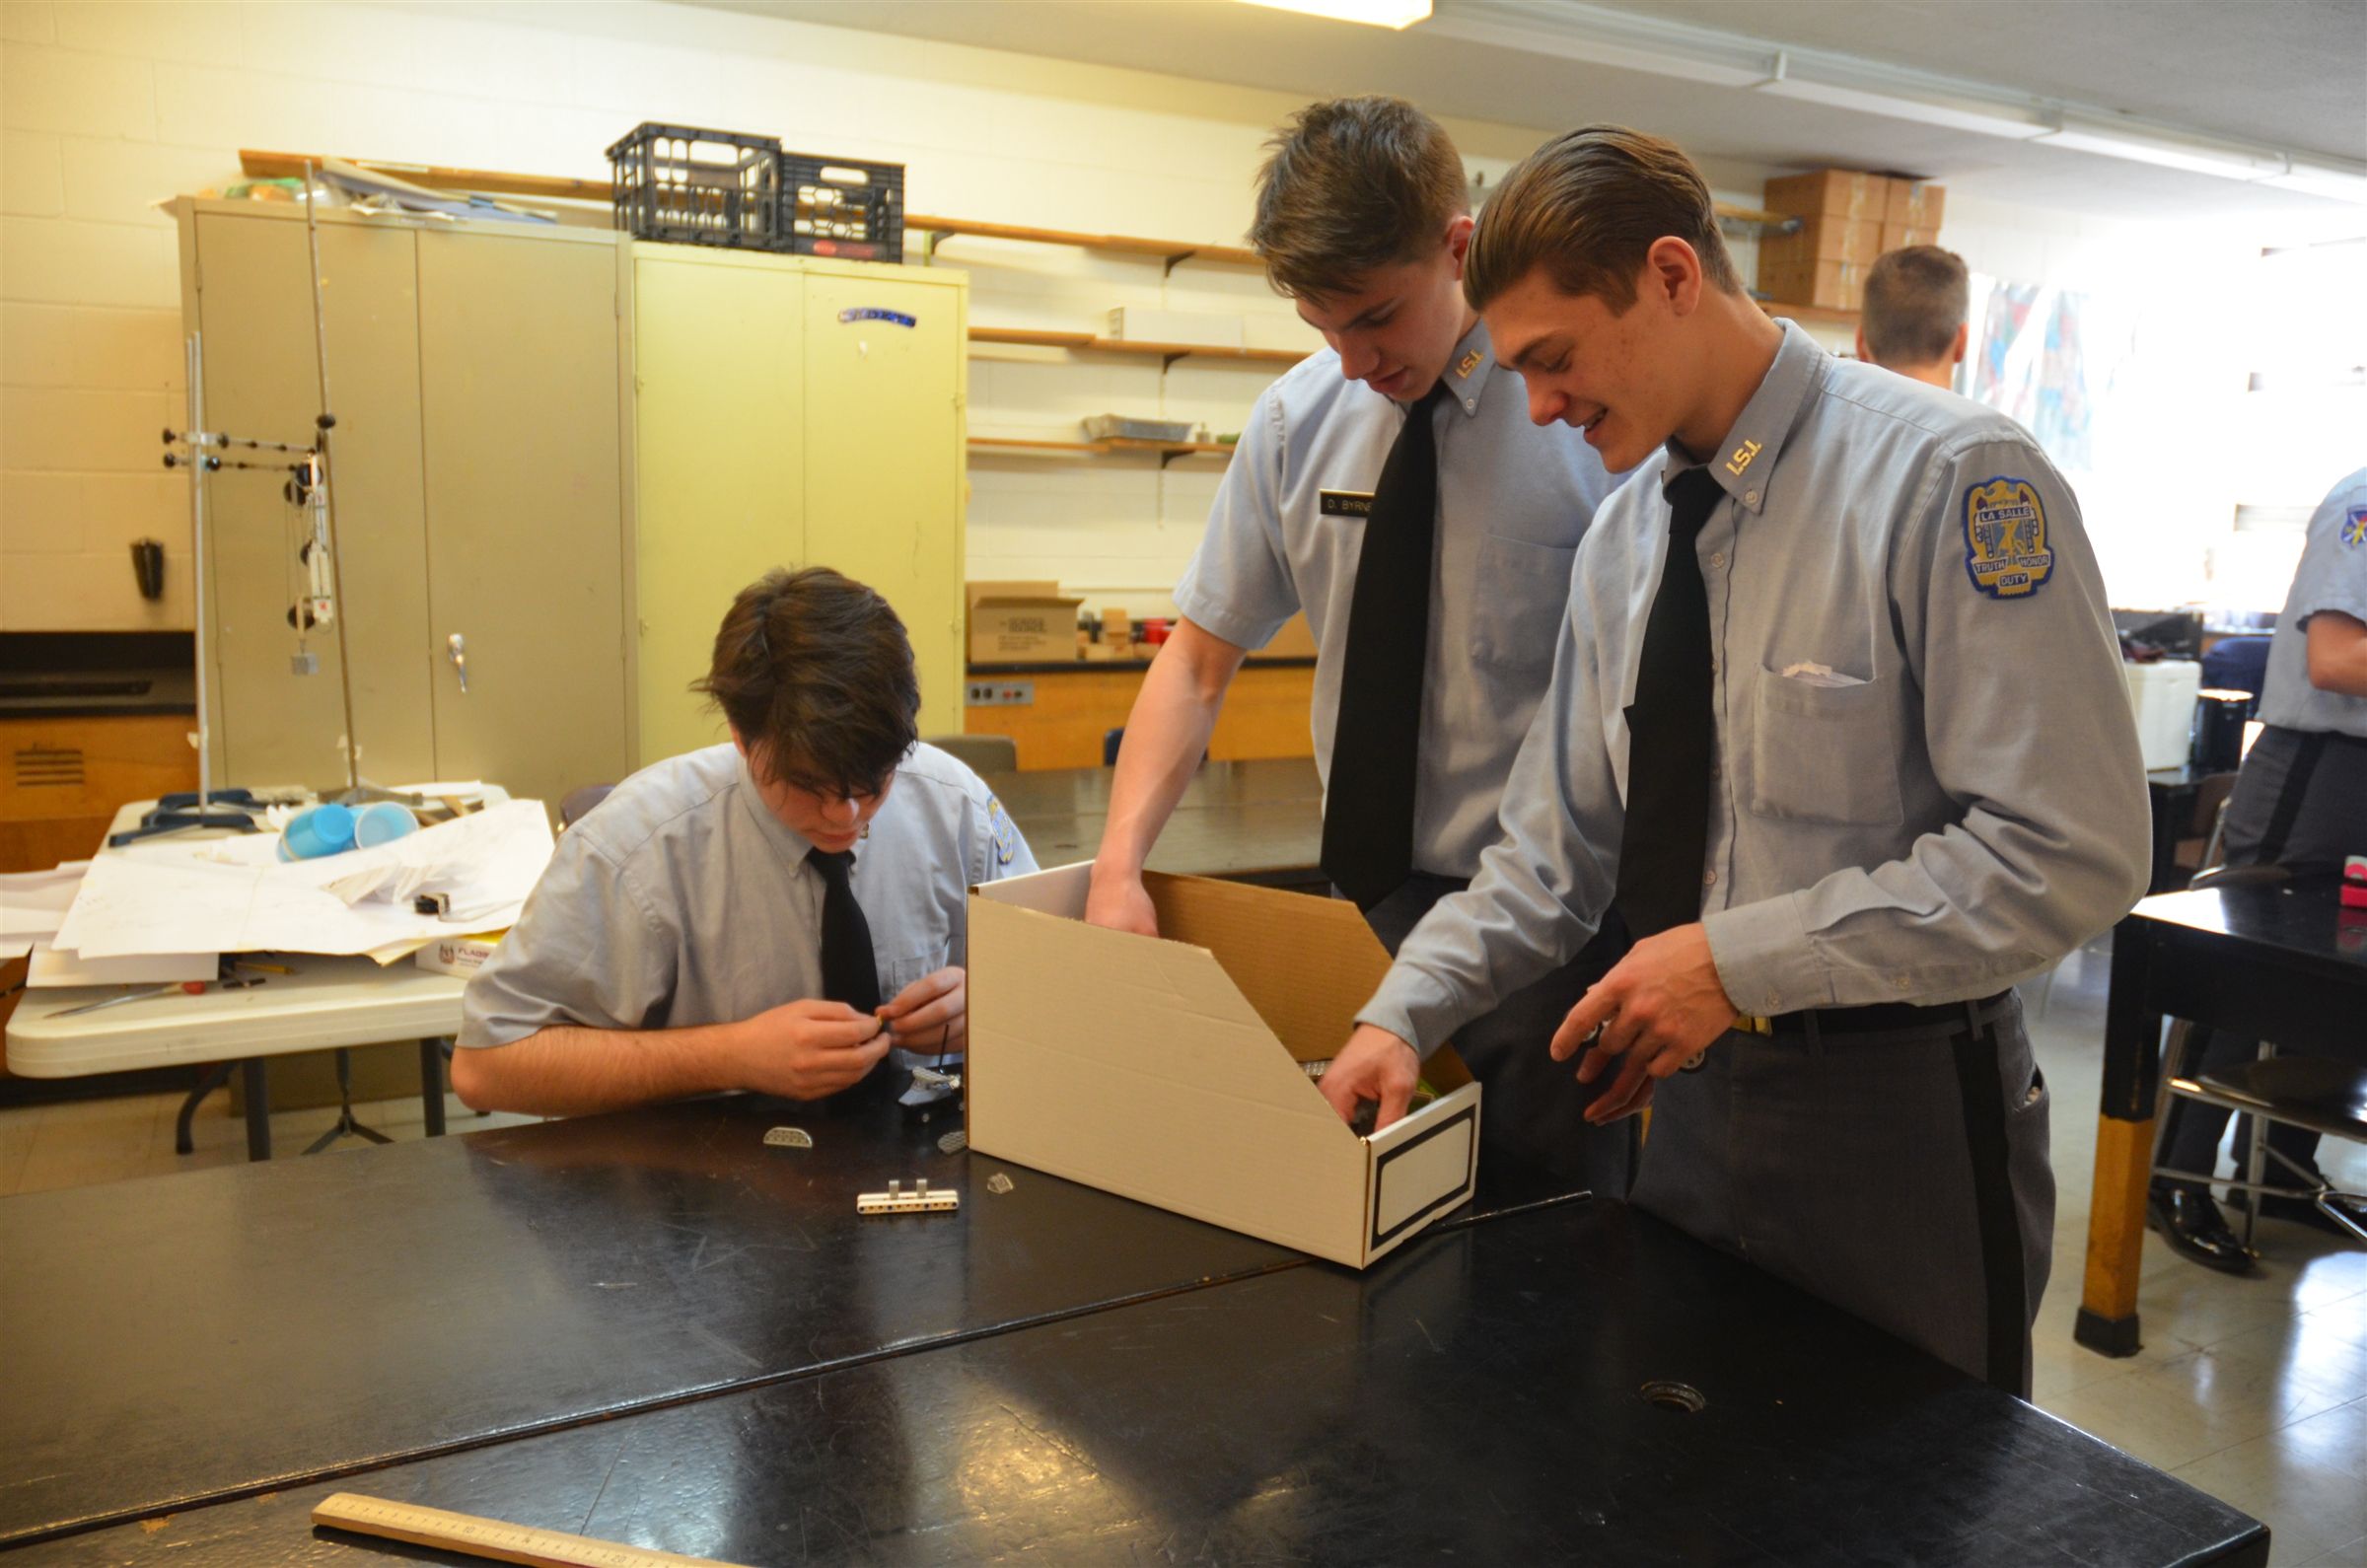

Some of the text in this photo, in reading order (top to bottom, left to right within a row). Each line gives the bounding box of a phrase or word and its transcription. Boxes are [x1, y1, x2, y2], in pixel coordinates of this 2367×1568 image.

[1980, 507, 2031, 522] LA SALLE
[1975, 559, 2005, 572] TRUTH
[2020, 555, 2049, 567] HONOR
[2000, 574, 2028, 586] DUTY
